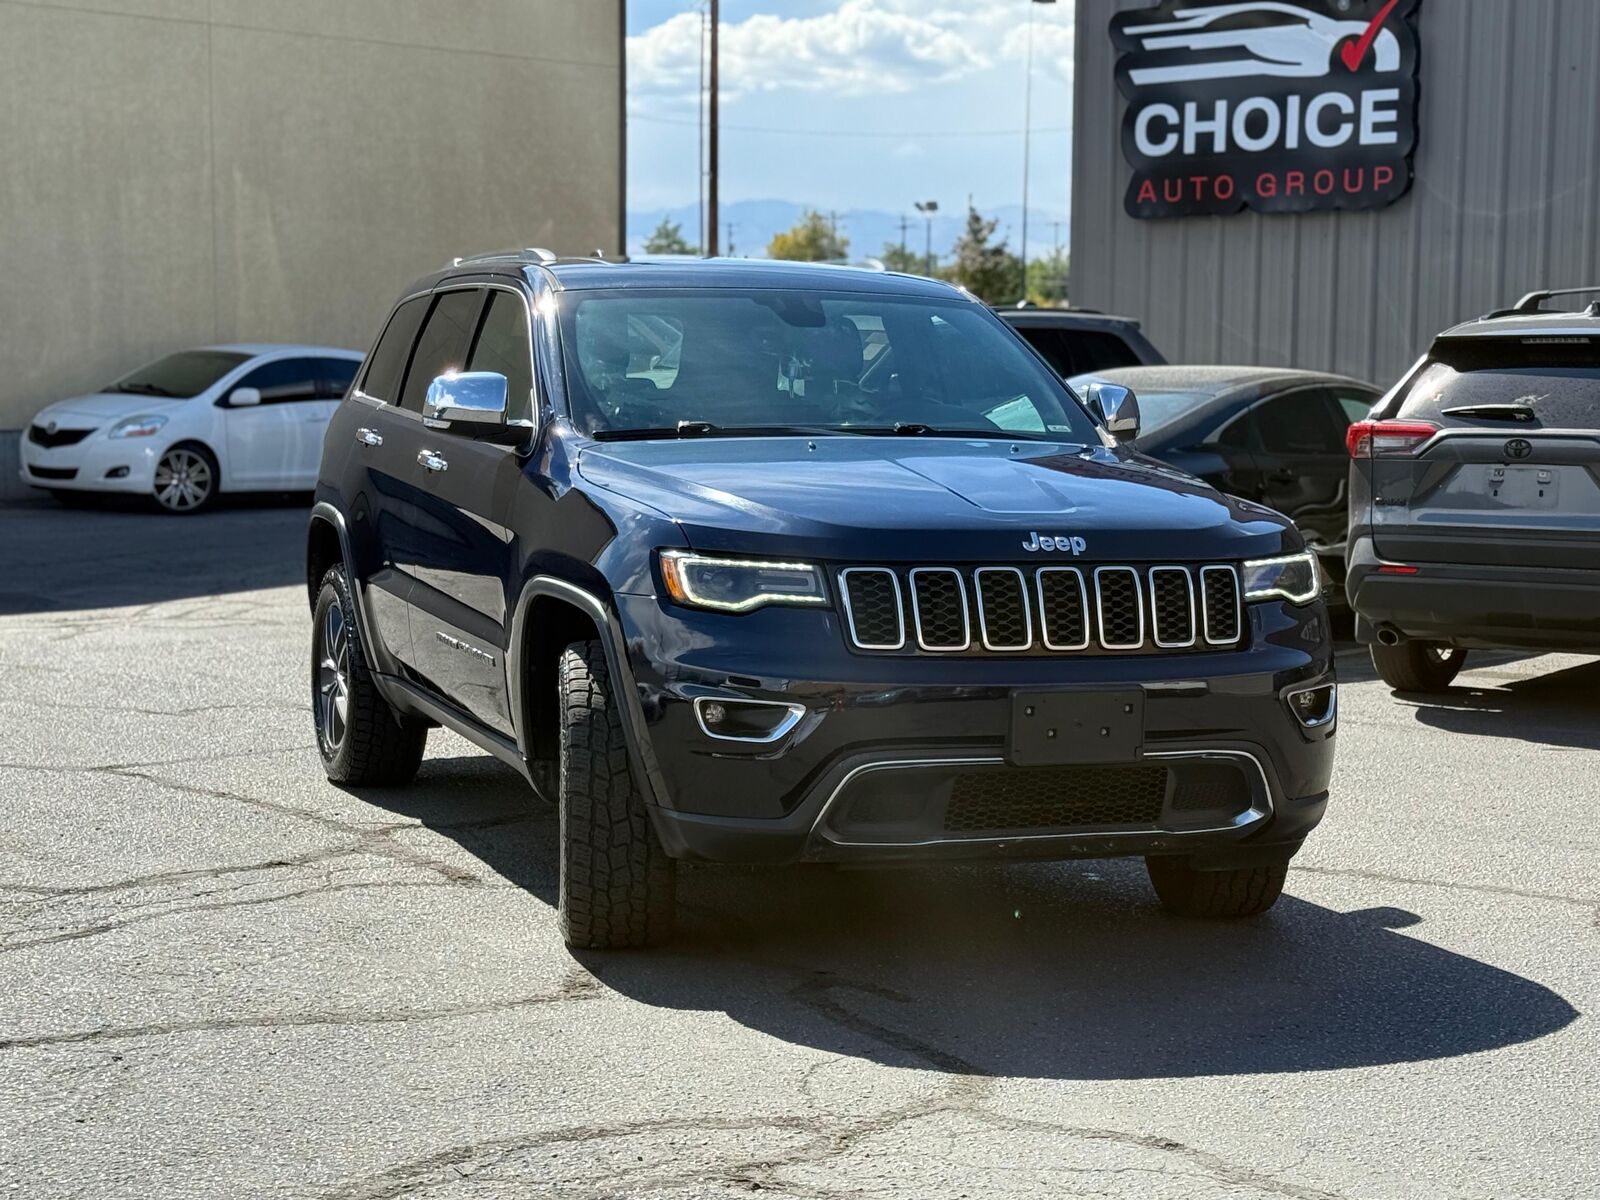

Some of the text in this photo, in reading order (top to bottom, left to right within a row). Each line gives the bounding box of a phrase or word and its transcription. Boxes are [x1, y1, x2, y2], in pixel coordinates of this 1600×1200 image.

[1134, 88, 1400, 157] CHOICE
[1137, 166, 1394, 203] AUTO GROUP
[1022, 532, 1087, 556] Jeep
